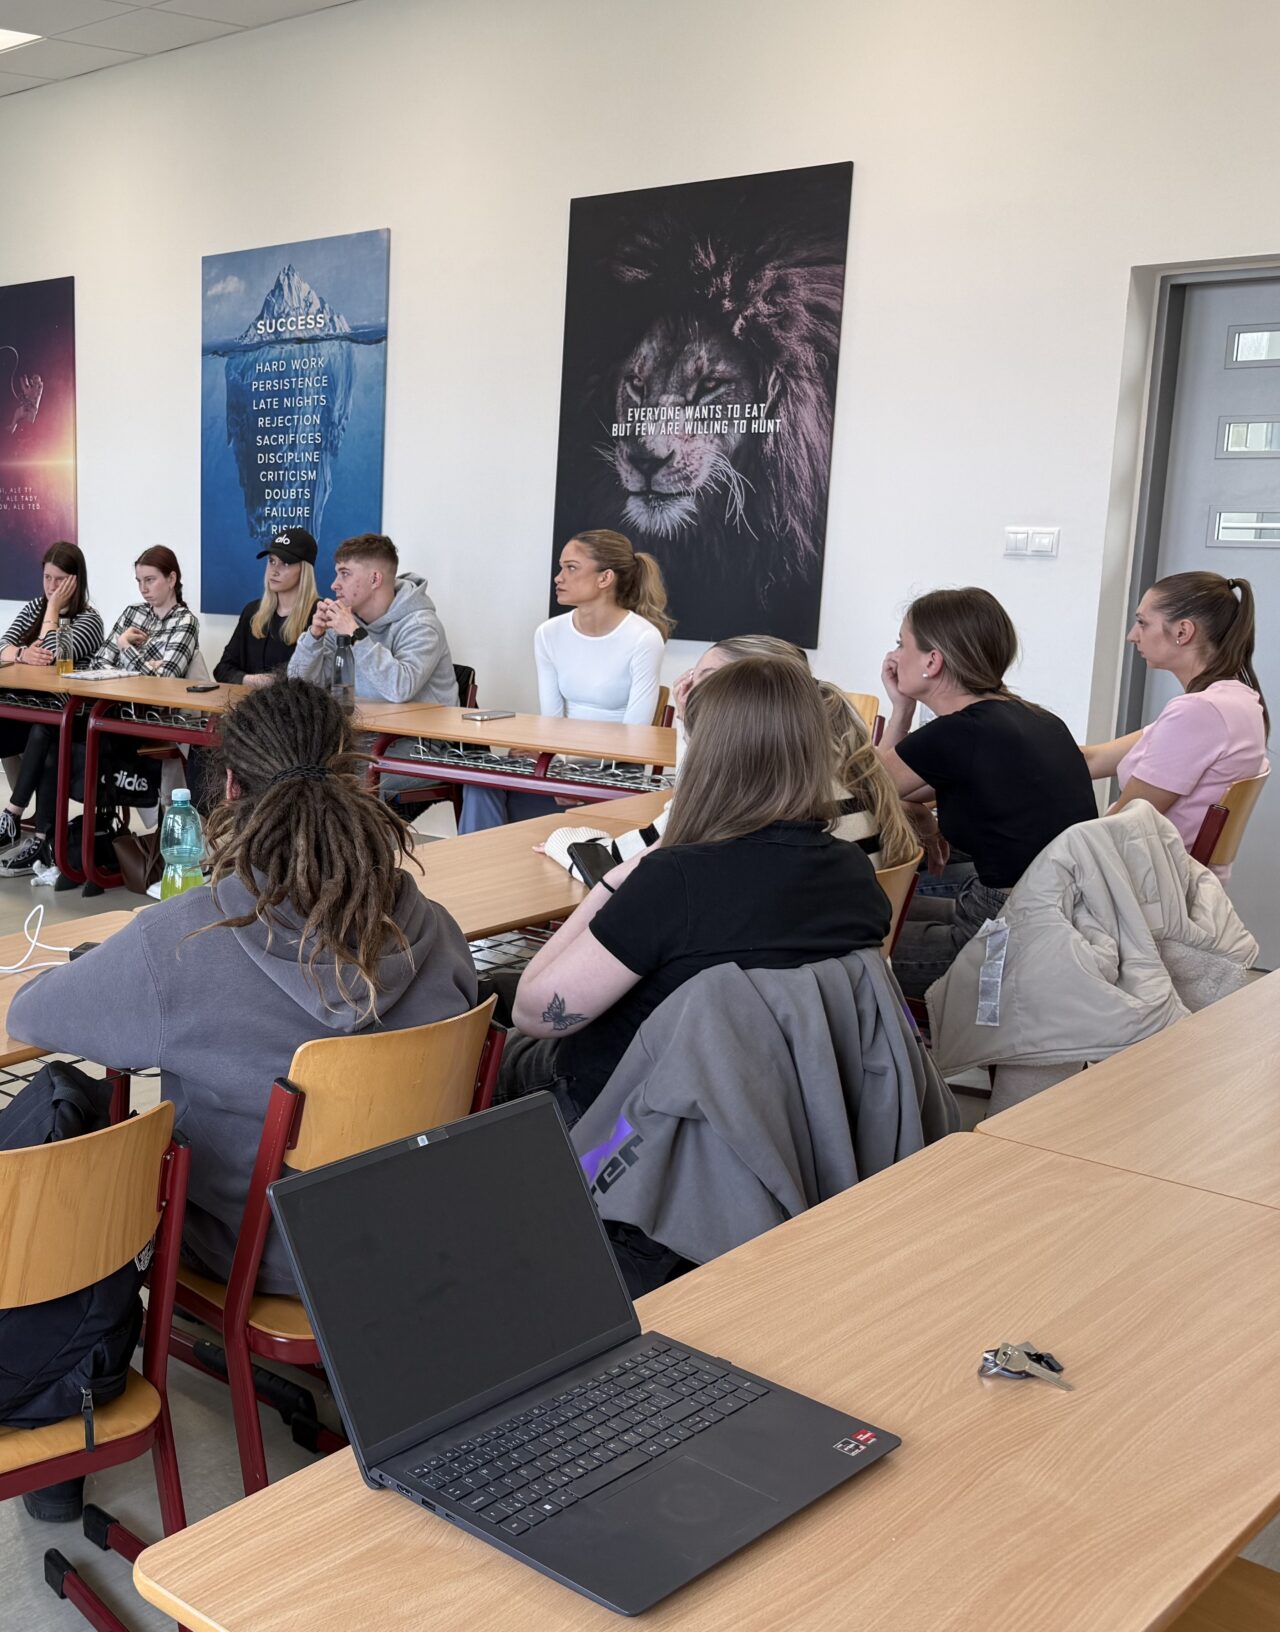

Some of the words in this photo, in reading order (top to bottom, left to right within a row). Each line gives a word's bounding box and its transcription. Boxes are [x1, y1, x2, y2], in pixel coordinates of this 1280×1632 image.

[257, 313, 325, 334] SUCCESS
[256, 360, 287, 373] HARD
[291, 357, 325, 369] WORK
[252, 375, 328, 392] PERSISTENCE
[252, 397, 279, 410] LATE
[284, 394, 327, 408] NIGHTS
[627, 406, 681, 421] EVERYONE
[685, 405, 722, 419] WANTS
[728, 404, 740, 418] TO
[745, 403, 766, 417] EAT
[258, 414, 321, 428] REJECTION
[612, 423, 632, 436] BUT
[635, 423, 655, 436] FEW
[660, 422, 680, 435] ARE
[684, 421, 728, 434] WILLING
[733, 420, 746, 433] TO
[751, 419, 781, 433] HUNT
[256, 433, 322, 447] SACRIFICES
[257, 452, 320, 464] DISCIPLINE
[259, 471, 317, 482] CRITICISM
[264, 488, 310, 500] DOUBTS
[265, 506, 310, 517] FAILURE
